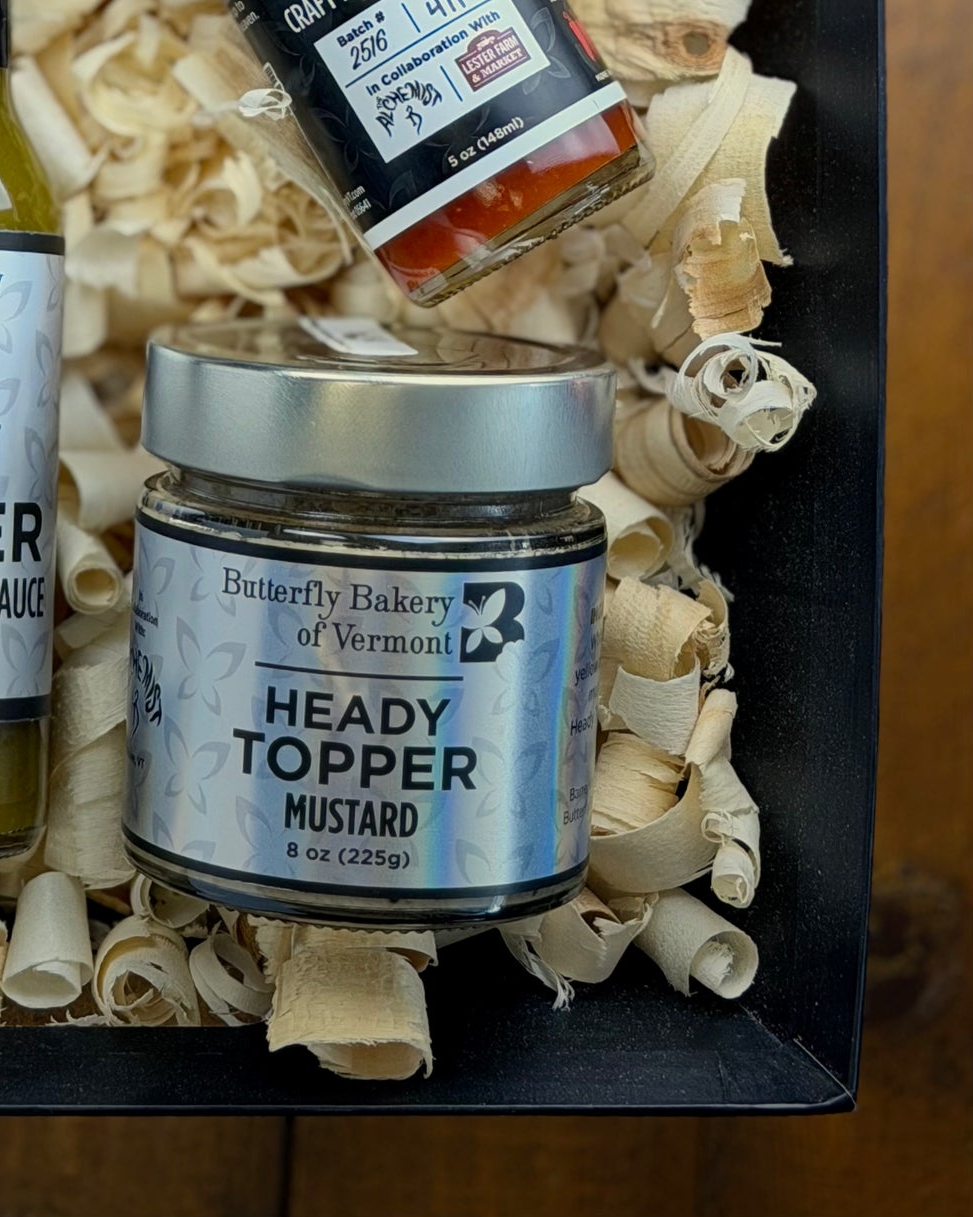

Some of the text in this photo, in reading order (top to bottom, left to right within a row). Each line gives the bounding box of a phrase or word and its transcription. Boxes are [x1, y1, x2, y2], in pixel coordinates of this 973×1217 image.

[336, 10, 386, 47] Batch #
[350, 28, 388, 70] 2516
[366, 10, 501, 96] In Collaboration With
[461, 35, 519, 75] LESTER FARM
[472, 48, 523, 83] & MARKET
[447, 116, 525, 168] 5 oz (148ml)
[222, 567, 455, 627] Butterfly Bakery
[297, 621, 453, 655] of Vermont
[265, 686, 451, 736] HEADY
[233, 727, 477, 791] TOPPER
[285, 792, 418, 838] MUSTARD
[286, 842, 411, 870] 8 oz (225g)
